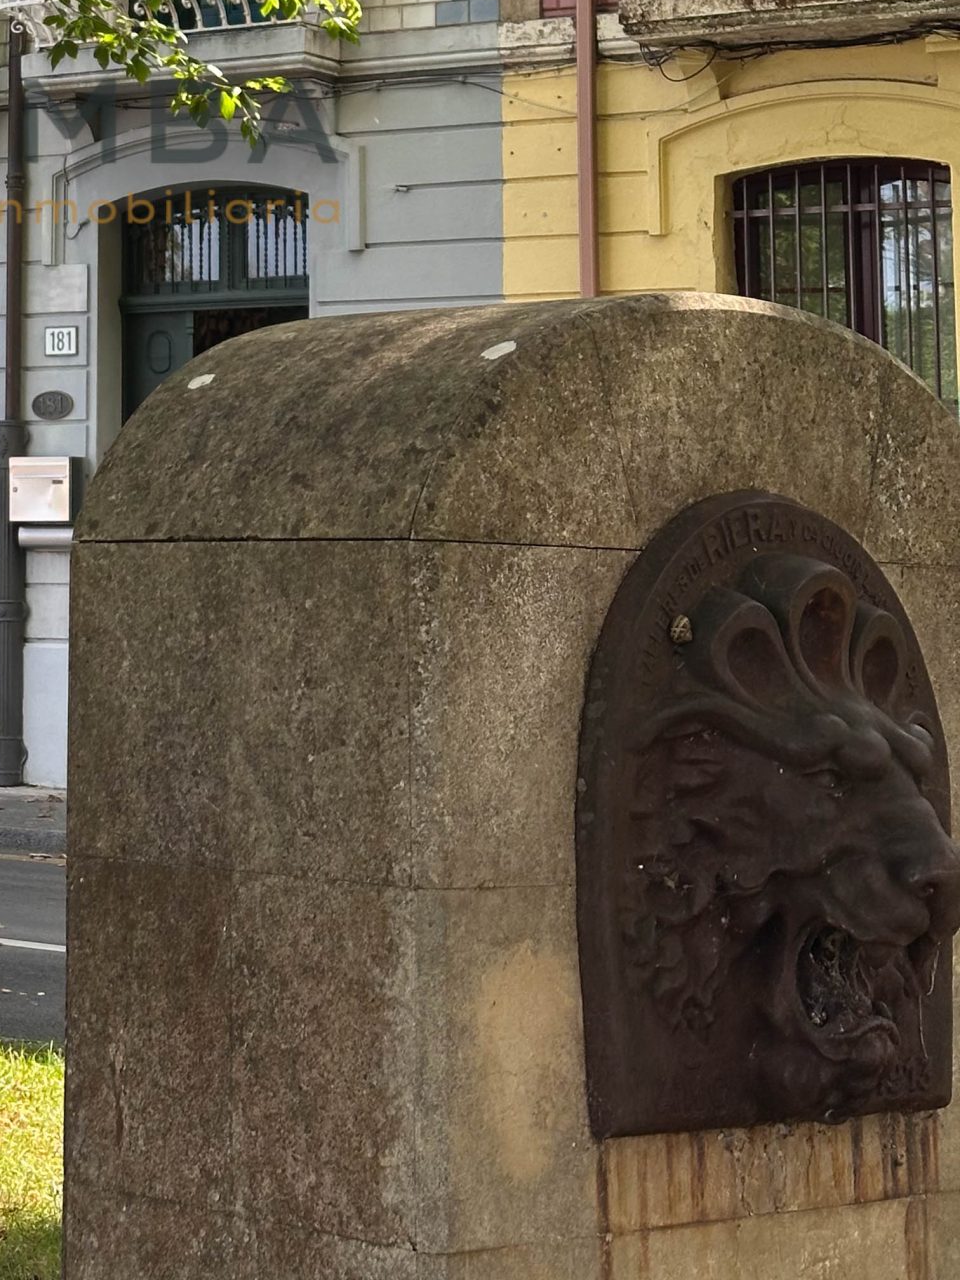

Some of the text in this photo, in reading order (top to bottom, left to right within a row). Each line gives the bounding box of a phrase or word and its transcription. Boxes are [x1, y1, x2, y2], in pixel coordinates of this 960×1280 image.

[49, 331, 72, 351] 181
[38, 395, 64, 414] 181
[700, 508, 786, 567] RIERA
